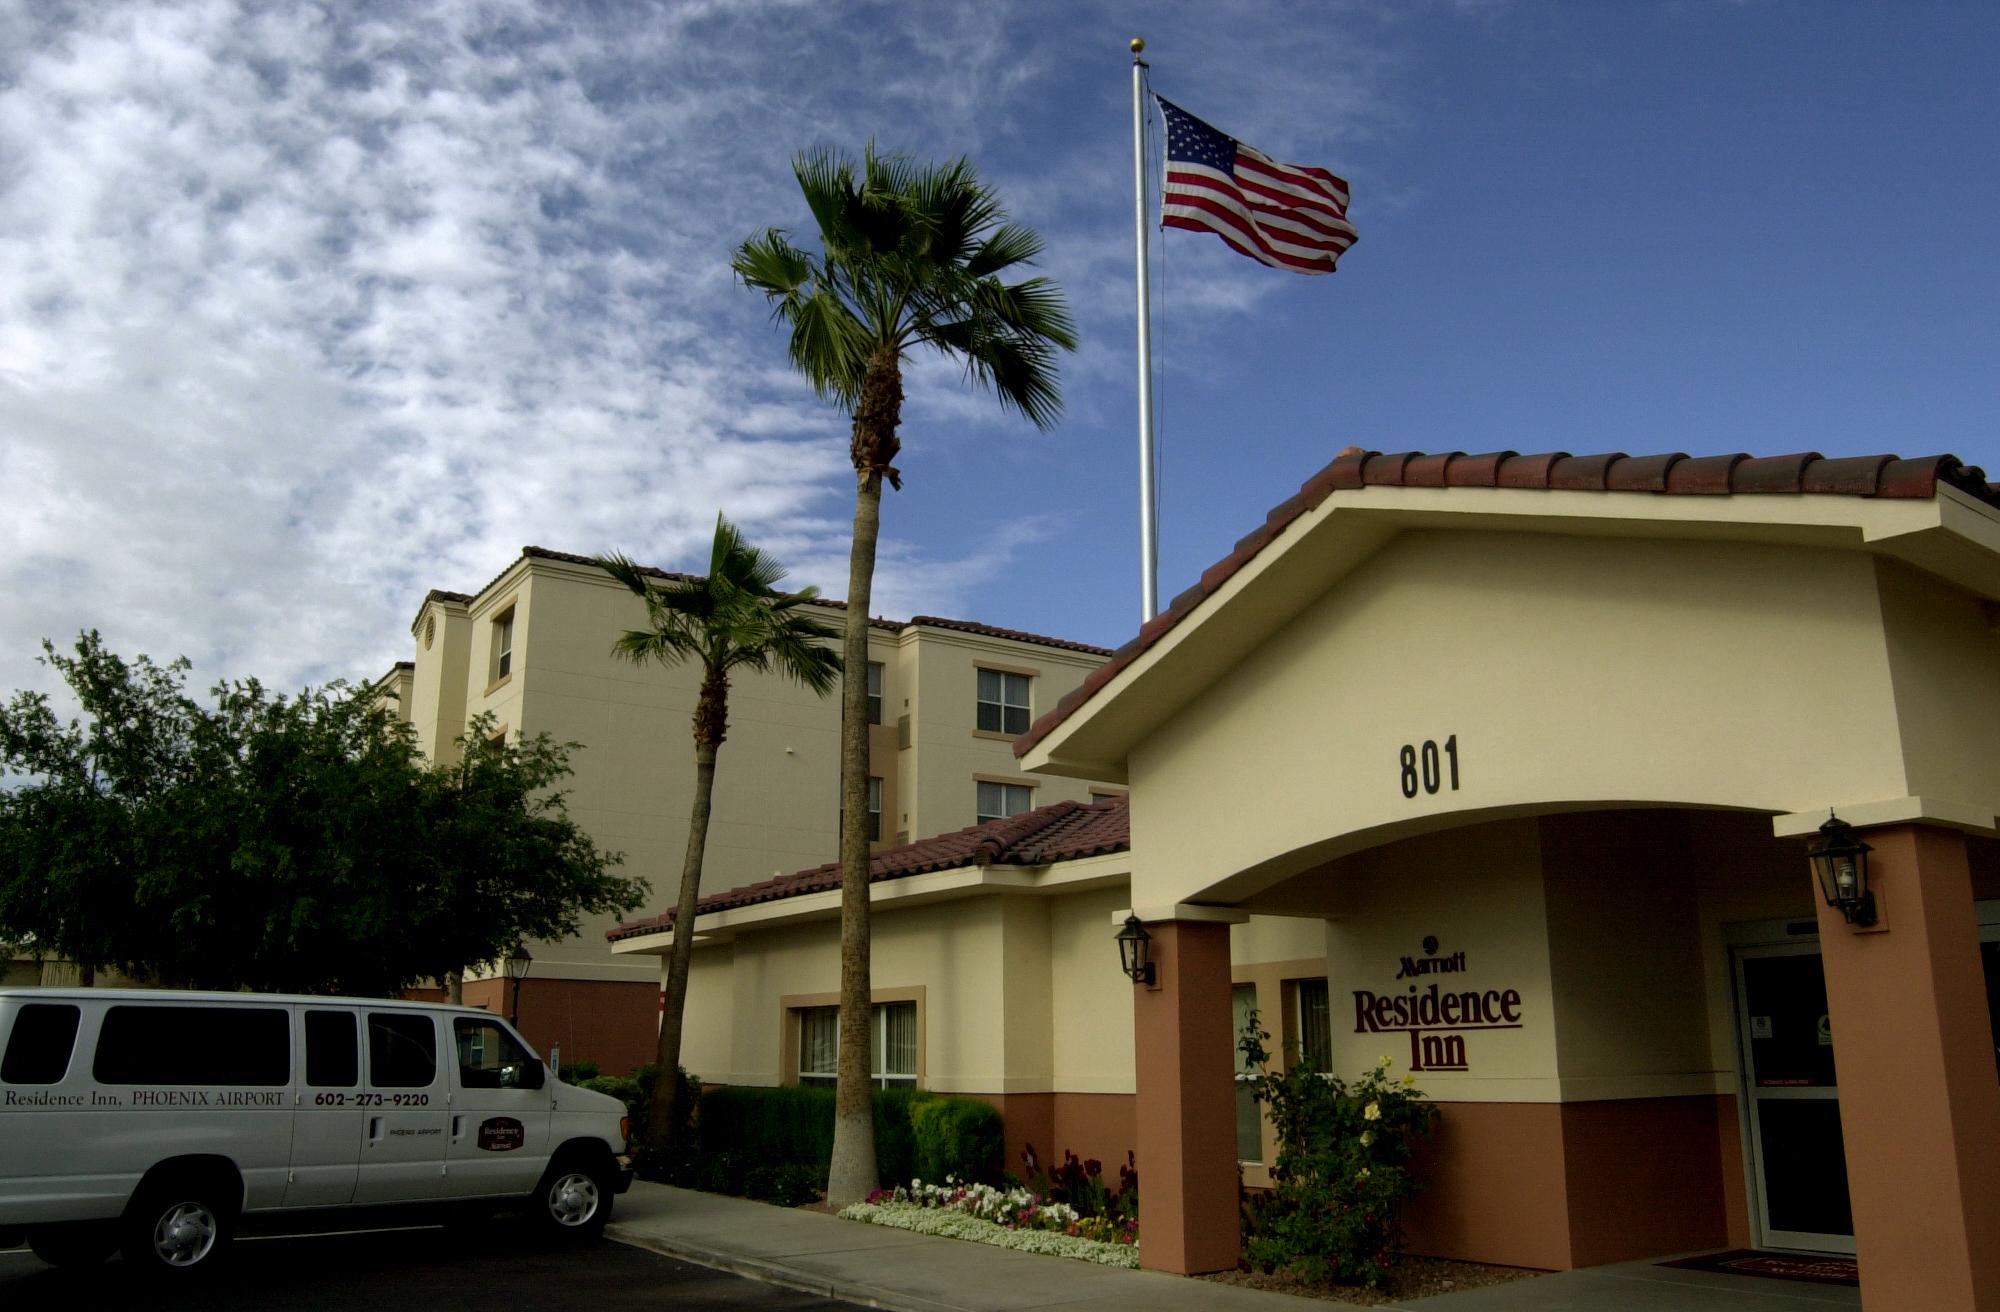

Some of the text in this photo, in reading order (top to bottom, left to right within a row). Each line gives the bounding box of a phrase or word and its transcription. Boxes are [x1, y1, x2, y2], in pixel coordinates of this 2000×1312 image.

[1400, 734, 1459, 799] 801
[1396, 951, 1466, 980] Marriott
[1352, 984, 1521, 1033] Residence
[1408, 1029, 1468, 1071] Inn
[5, 1090, 285, 1108] Residence Inn, PHOENIX AIRPORT
[315, 1093, 429, 1106] 602-273-9220
